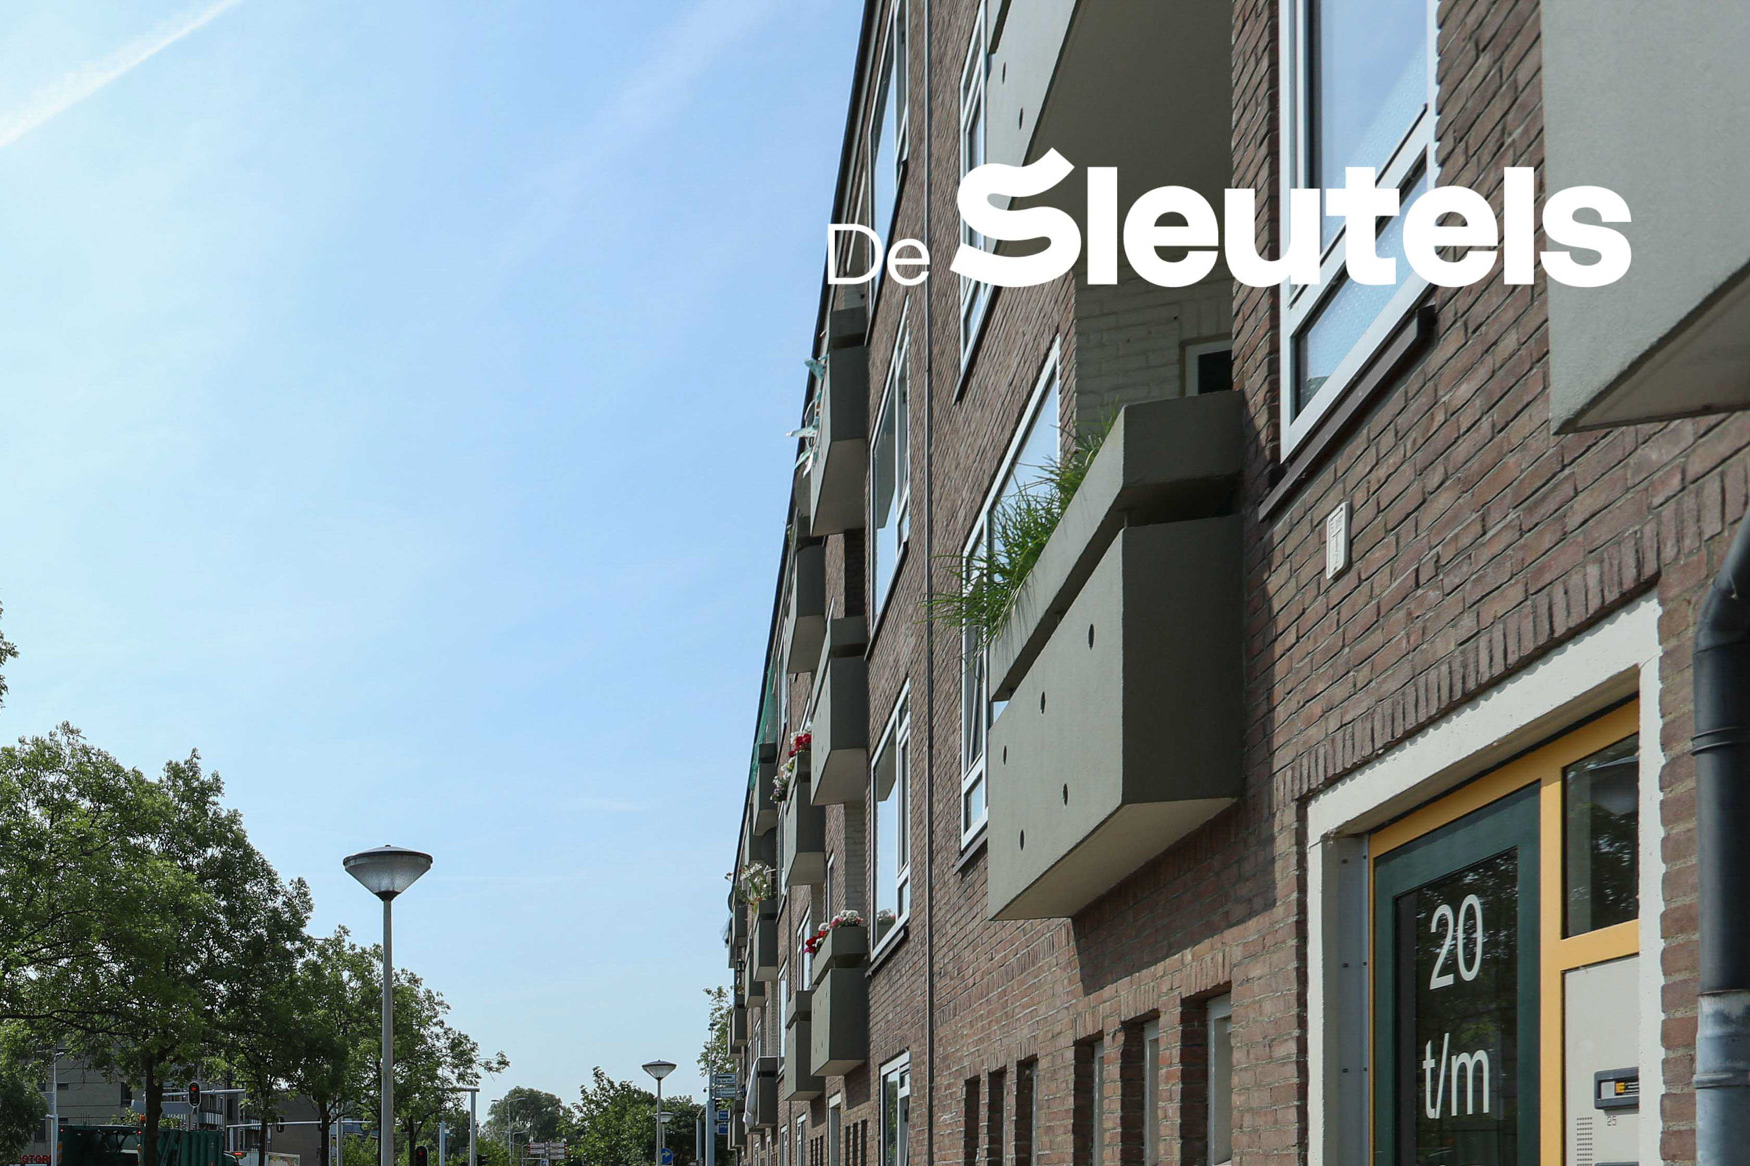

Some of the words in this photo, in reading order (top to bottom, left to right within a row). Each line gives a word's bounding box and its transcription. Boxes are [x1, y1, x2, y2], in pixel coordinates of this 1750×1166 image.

[1429, 893, 1483, 990] 20
[1422, 1032, 1490, 1120] t/m
[1606, 1115, 1617, 1127] 25
